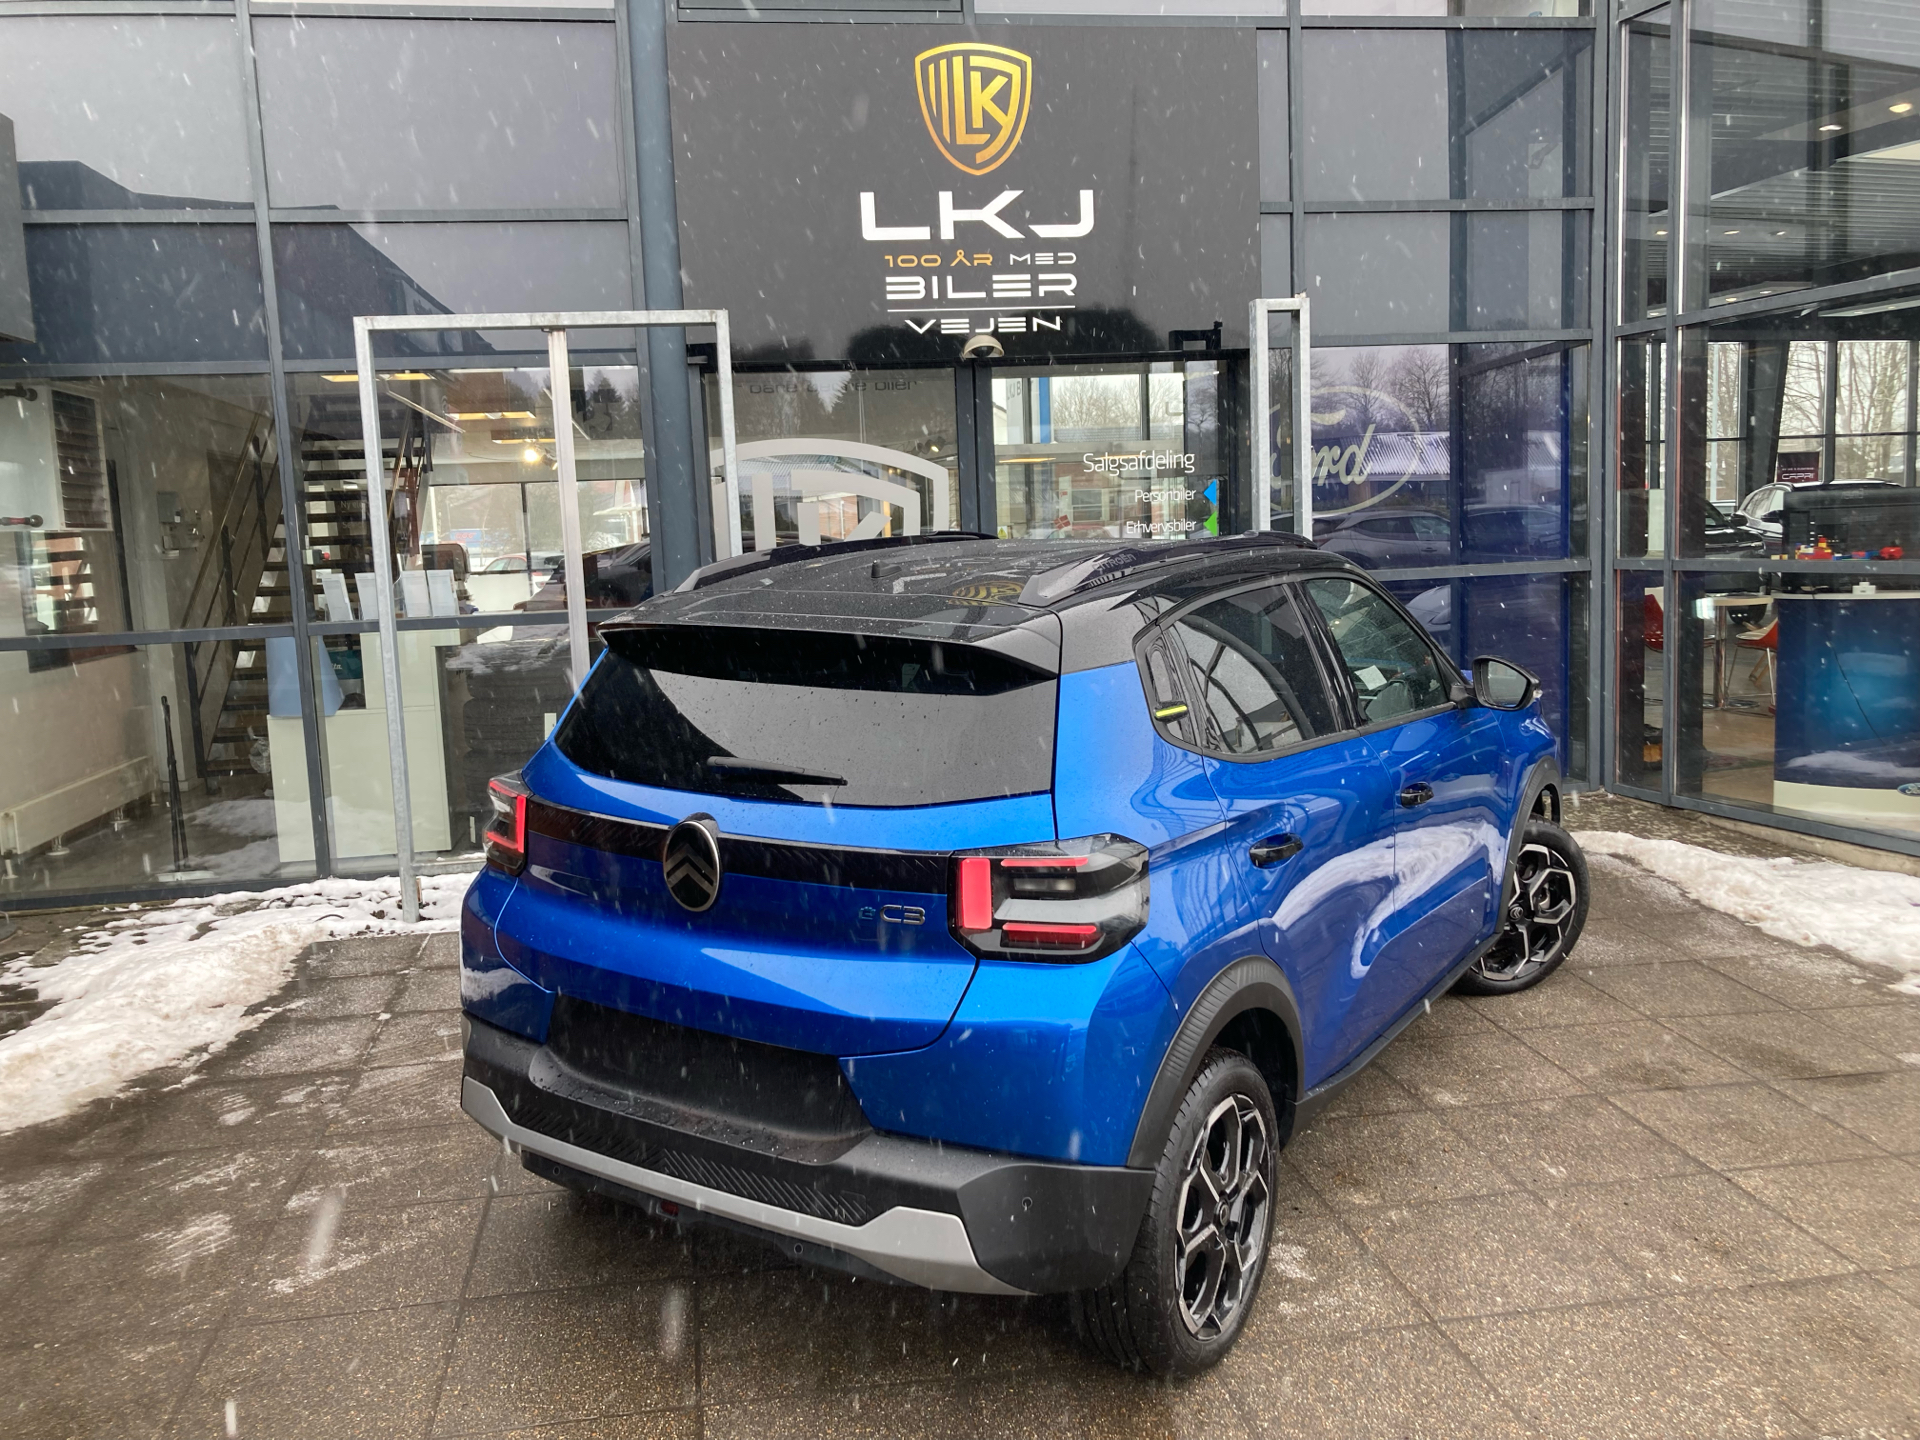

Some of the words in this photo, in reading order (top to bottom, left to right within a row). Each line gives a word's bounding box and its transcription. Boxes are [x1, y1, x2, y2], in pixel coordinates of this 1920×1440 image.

[860, 189, 1094, 241] LKJ
[884, 255, 942, 268] 100
[950, 249, 993, 267] ÅR
[1010, 252, 1077, 266] MED
[885, 273, 1078, 300] BILER
[904, 316, 1062, 335] VEJEN
[1083, 450, 1196, 477] Salgsafdeling
[1134, 488, 1197, 503] Personbiler
[1126, 519, 1197, 534] Erhvervsbiler
